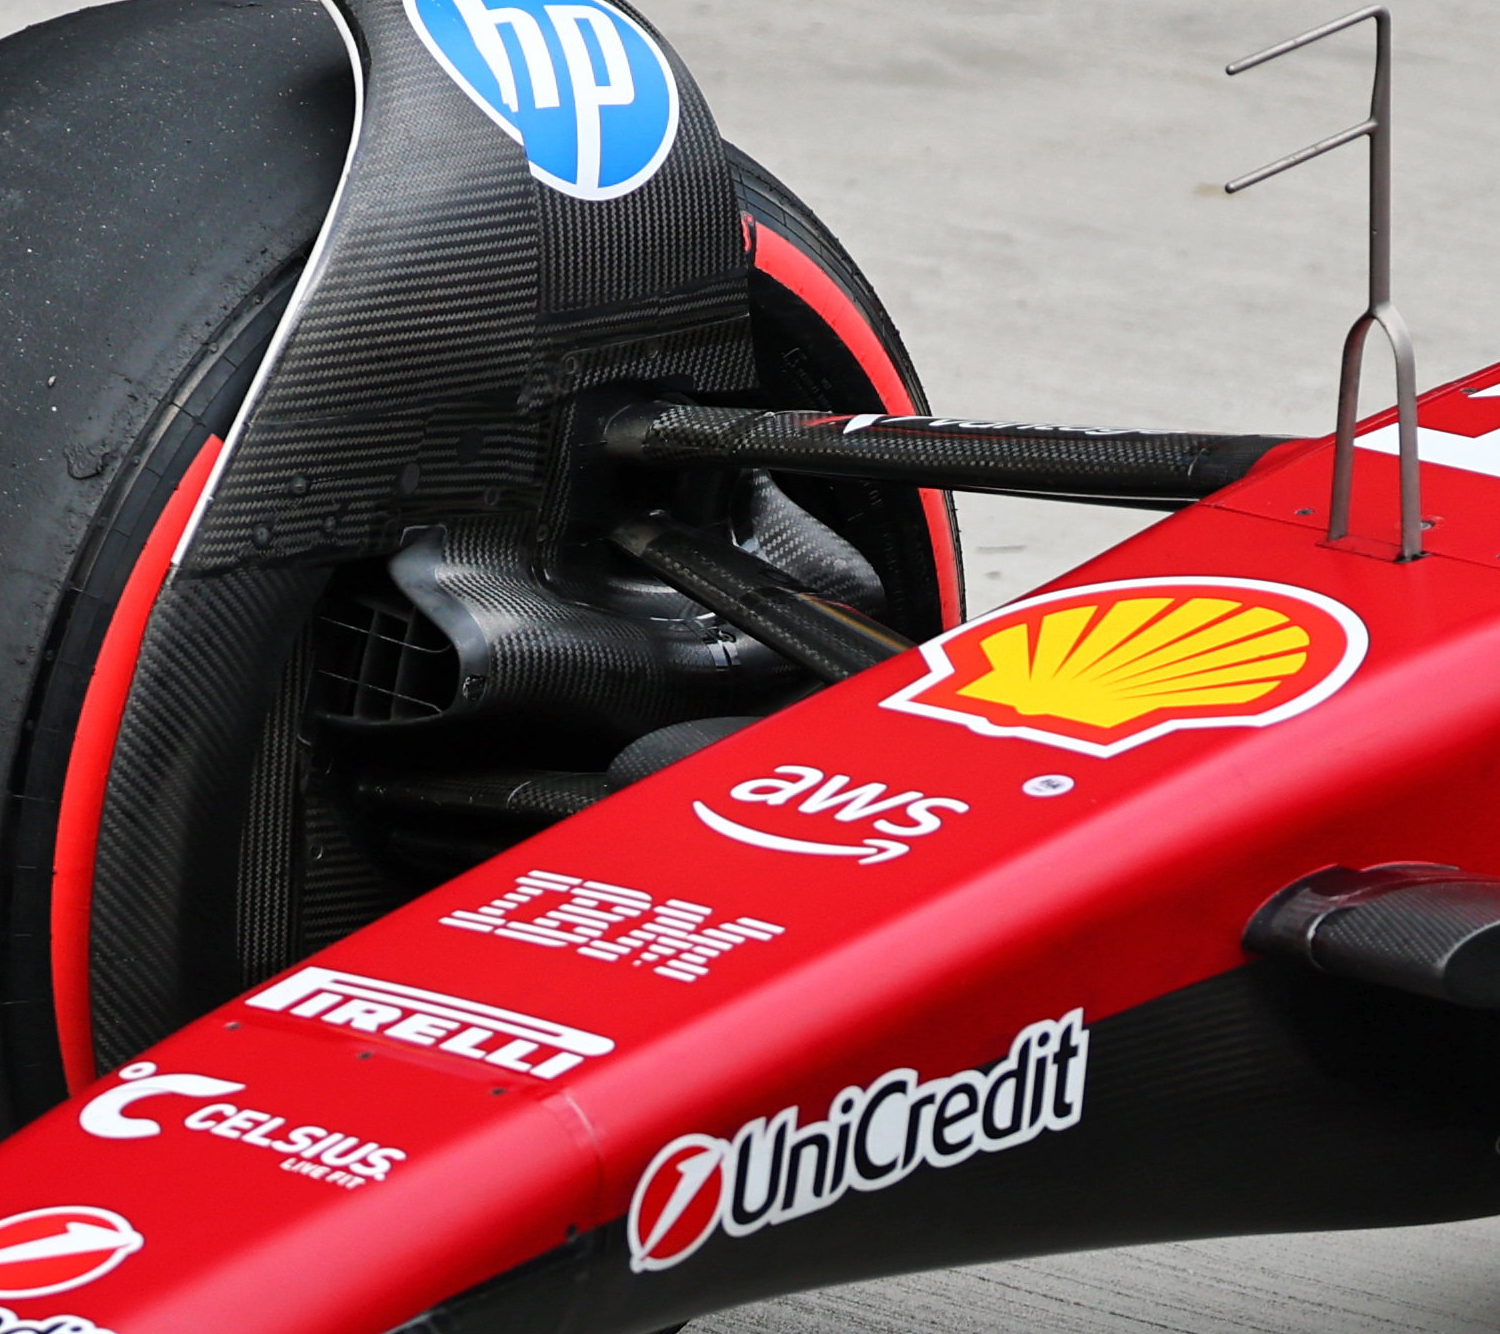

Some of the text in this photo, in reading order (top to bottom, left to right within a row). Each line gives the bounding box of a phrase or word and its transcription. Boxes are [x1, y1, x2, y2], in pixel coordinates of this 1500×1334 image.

[729, 764, 970, 839] aws
[438, 869, 787, 983] IBM
[245, 965, 617, 1080] PIRELLI
[279, 1156, 367, 1190] LIVE FIT
[731, 1021, 1084, 1223] UniCredit
